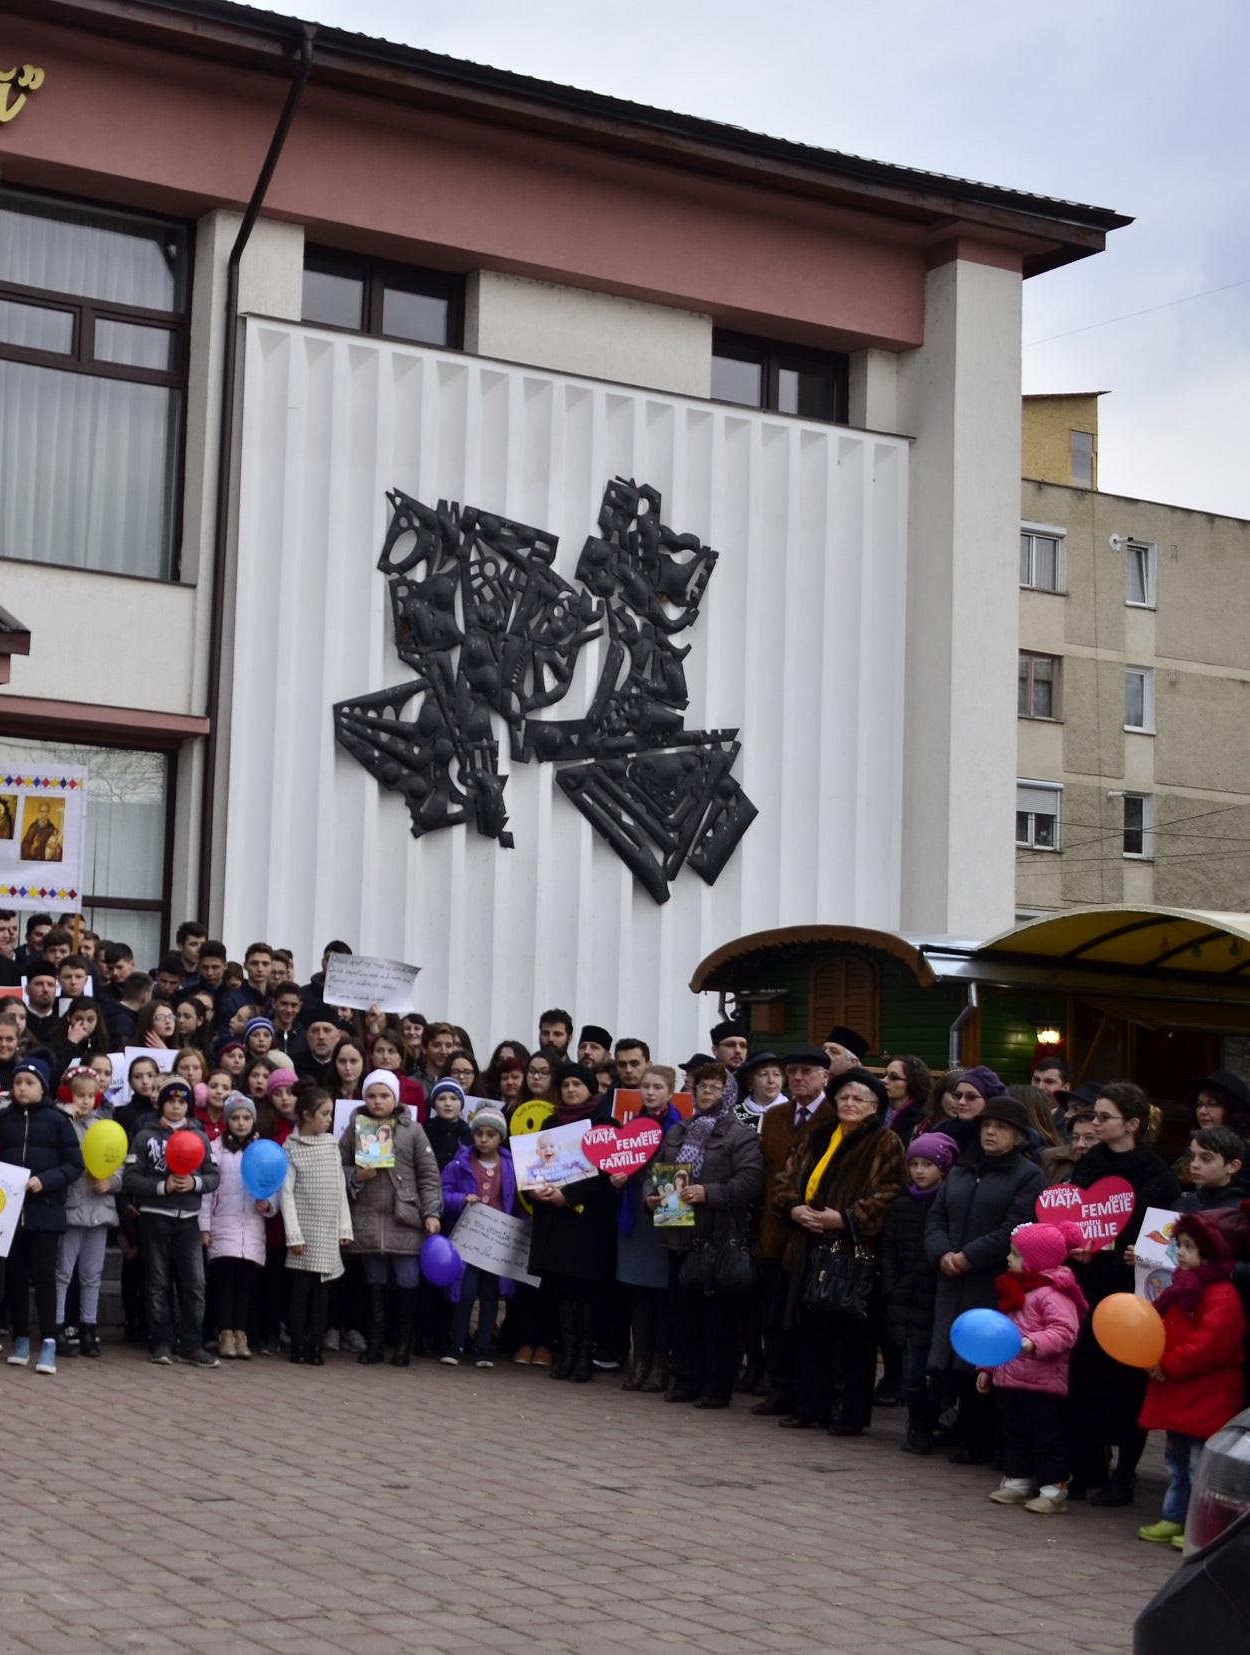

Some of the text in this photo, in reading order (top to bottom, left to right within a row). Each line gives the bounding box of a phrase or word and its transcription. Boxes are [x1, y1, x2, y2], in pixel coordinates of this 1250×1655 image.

[583, 1128, 617, 1145] VIAȚĂ
[616, 1135, 660, 1150] FEMEIE
[600, 1152, 647, 1169] FAMILIE
[1039, 1188, 1082, 1208] VIAȚĂ
[1043, 1188, 1070, 1197] pentru
[1109, 1192, 1134, 1201] pentru
[1081, 1199, 1132, 1218] FEMEIE
[1082, 1222, 1118, 1239] MILIE
